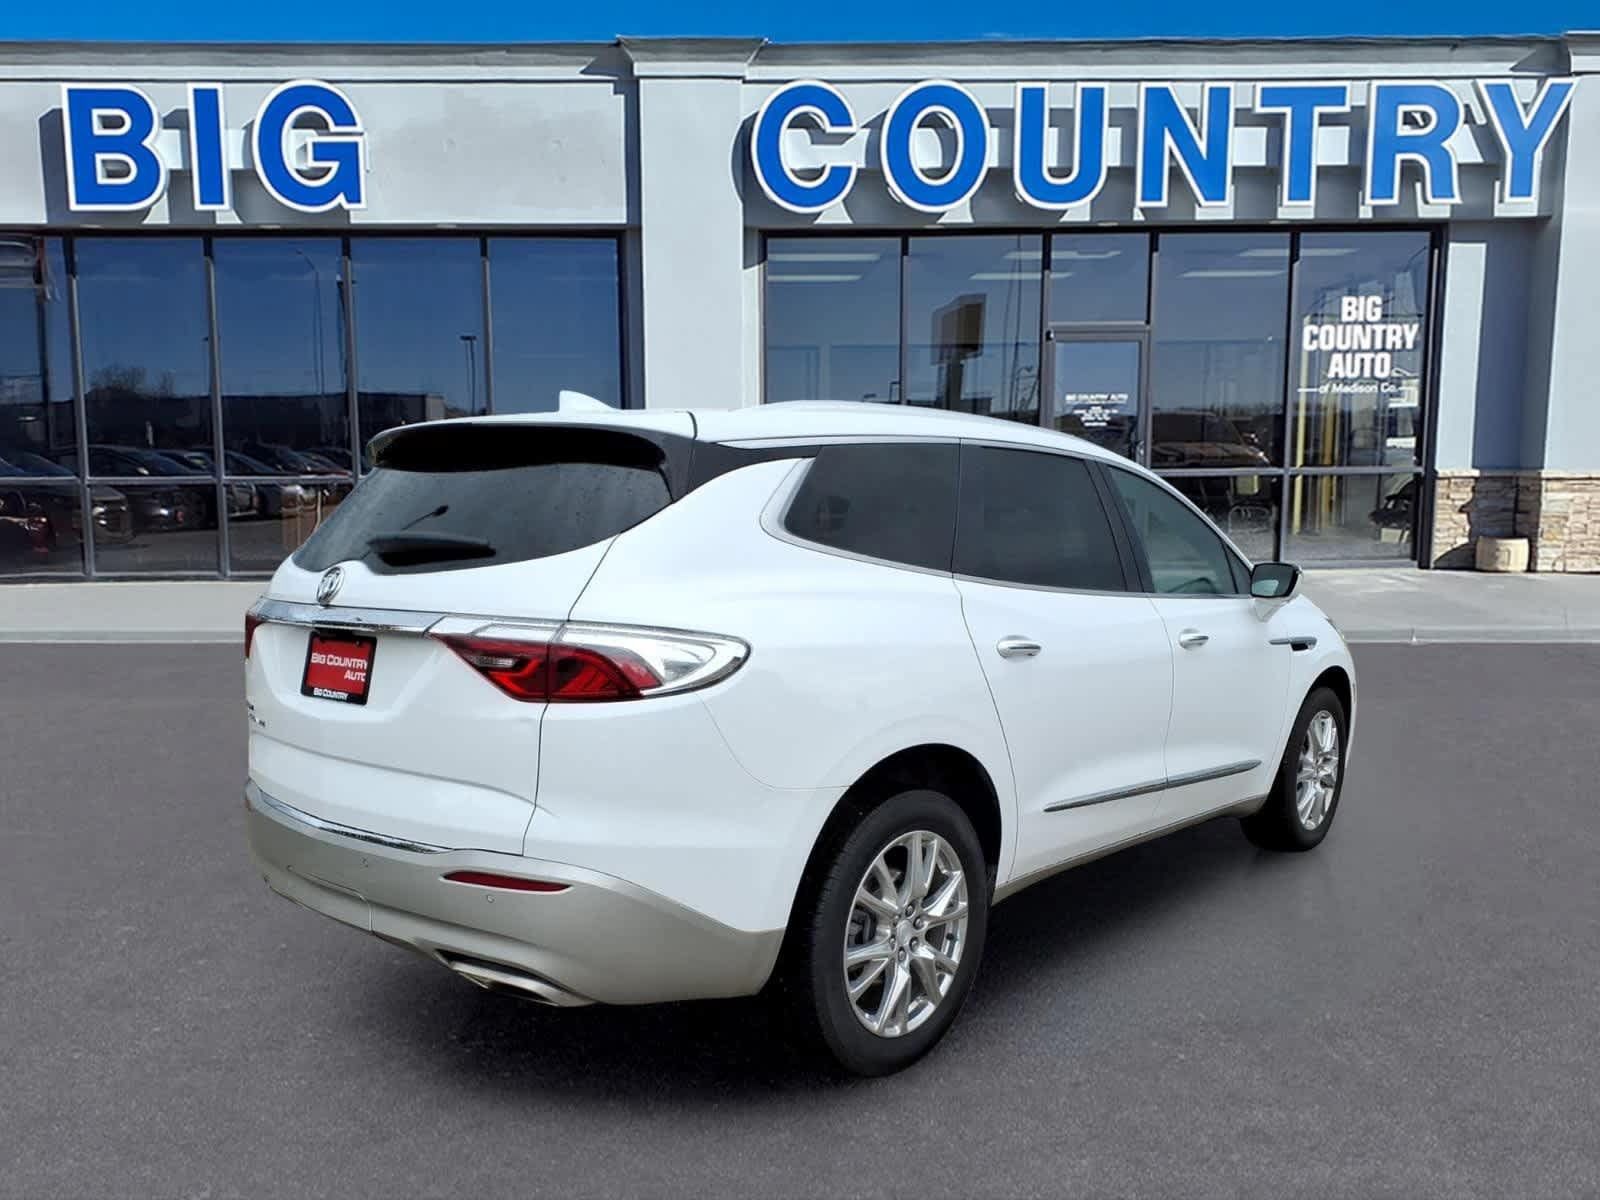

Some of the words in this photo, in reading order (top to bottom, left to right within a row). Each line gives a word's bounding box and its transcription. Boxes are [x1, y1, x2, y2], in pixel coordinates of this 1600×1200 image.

[61, 79, 368, 213] BIG
[750, 77, 1576, 215] COUNTRY
[1341, 295, 1383, 323] BIG
[1303, 323, 1419, 351] COUNTRY
[1327, 352, 1392, 379] AUTO
[1318, 382, 1331, 394] of
[1331, 382, 1378, 393] Madison
[311, 652, 326, 664] BIG
[326, 654, 368, 670] COUNTRY
[314, 687, 323, 696] BIG
[323, 688, 348, 699] COUNTRY
